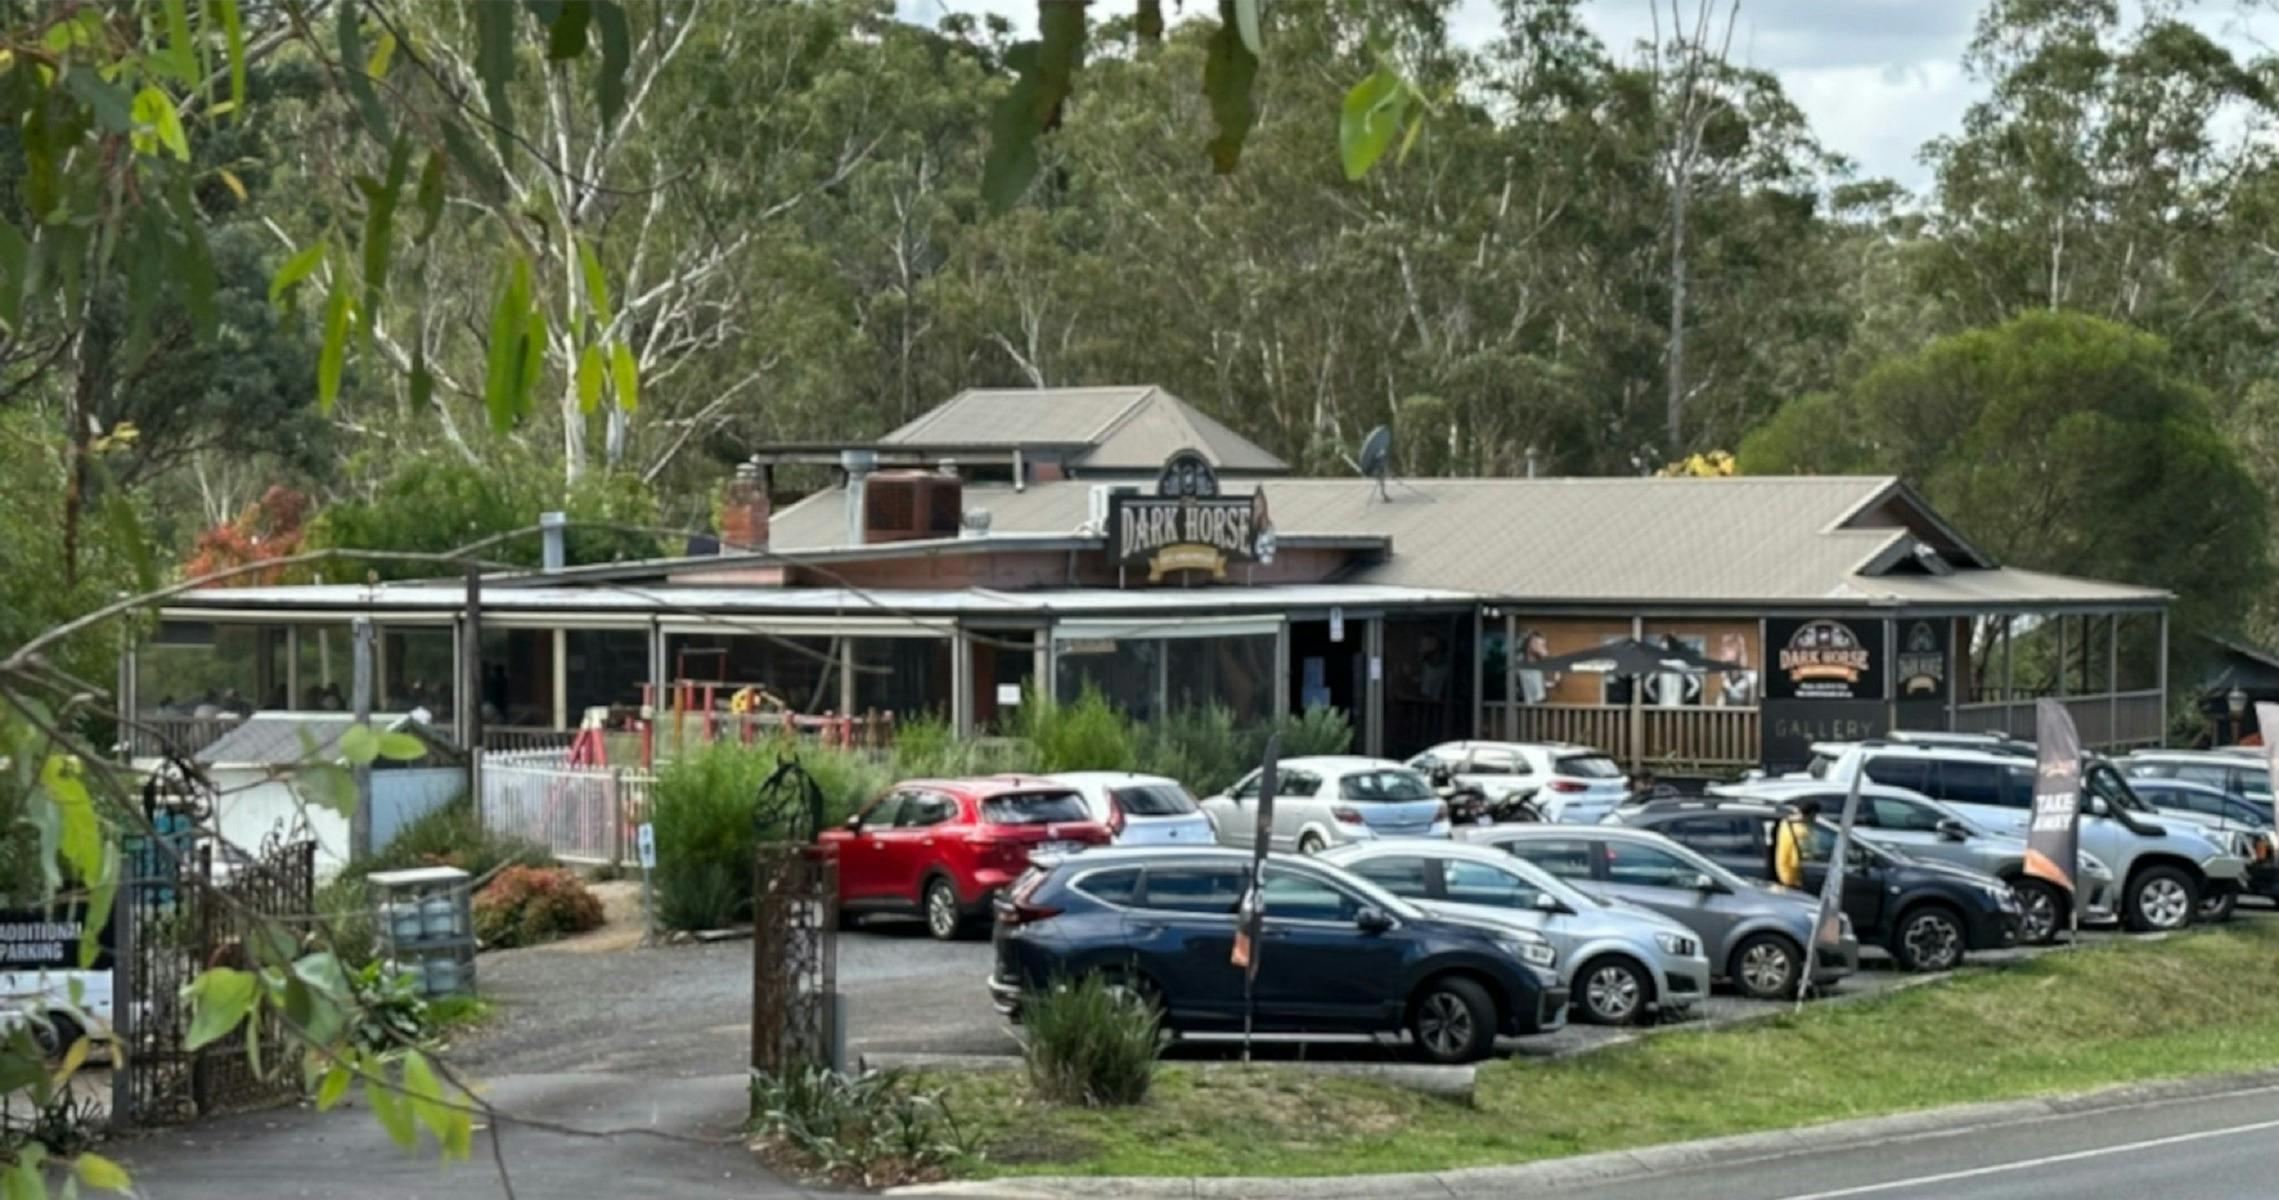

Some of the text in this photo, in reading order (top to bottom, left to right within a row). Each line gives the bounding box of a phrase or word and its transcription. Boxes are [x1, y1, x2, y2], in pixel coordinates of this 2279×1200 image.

[1120, 507, 1252, 559] DARK HORSE
[1779, 650, 1870, 670] DARK HORSE
[1775, 719, 1873, 740] GALLERY
[2036, 792, 2074, 813] TAKE
[0, 943, 64, 961] PARKING
